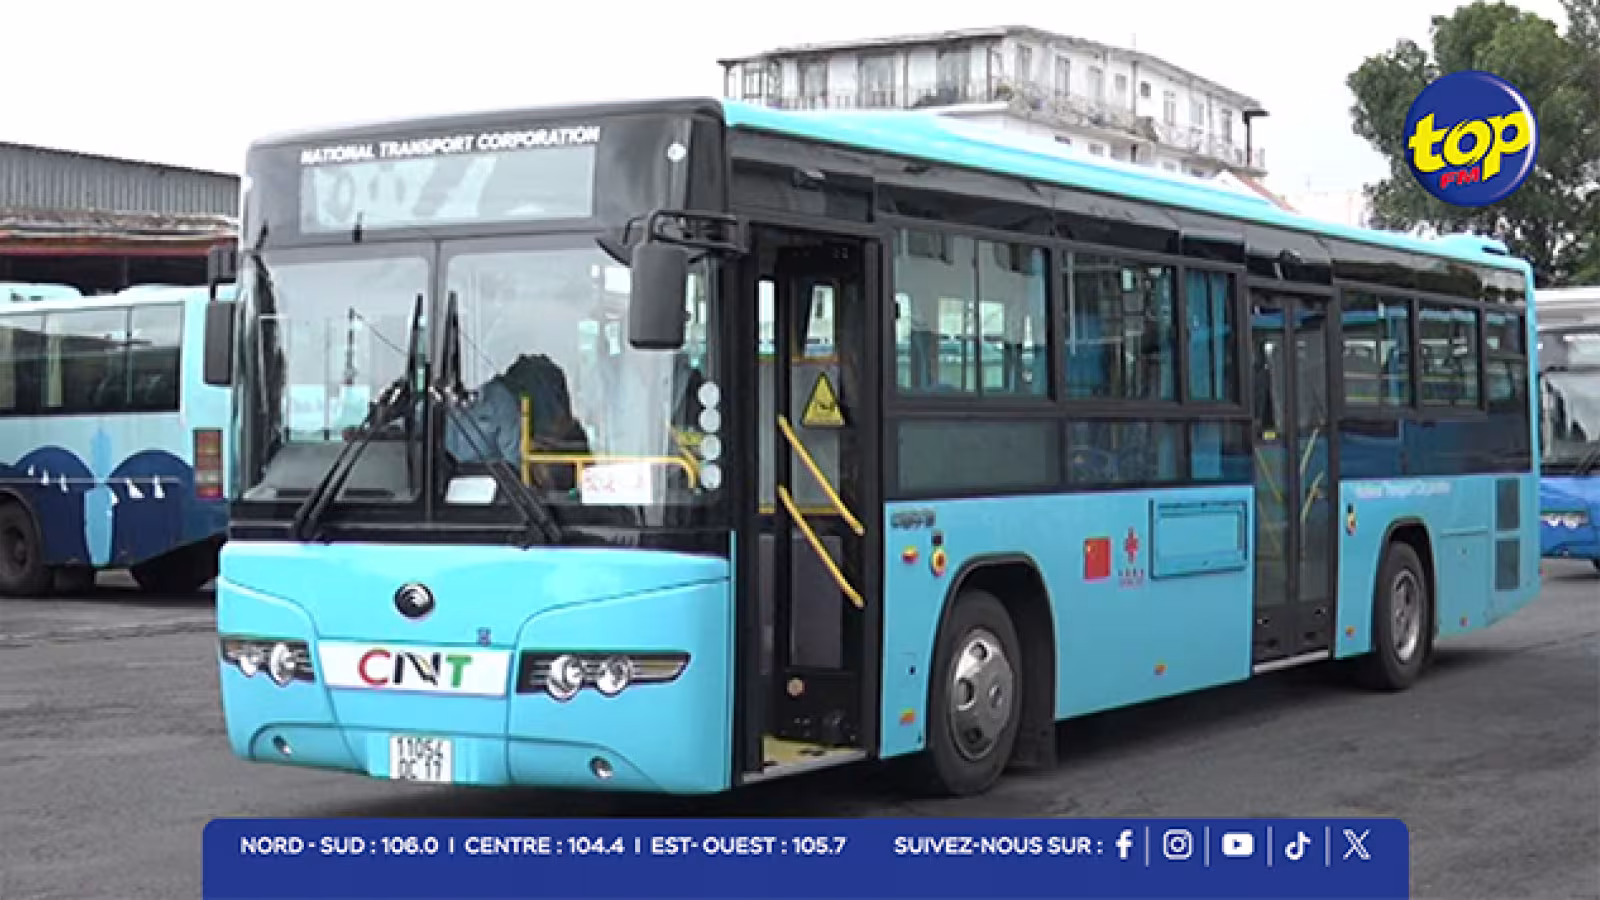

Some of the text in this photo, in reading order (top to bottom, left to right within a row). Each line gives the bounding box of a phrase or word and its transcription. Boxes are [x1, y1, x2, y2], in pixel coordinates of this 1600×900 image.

[301, 125, 600, 164] NATIONAL TRANSPORT CORPORATION
[358, 648, 473, 687] CNT
